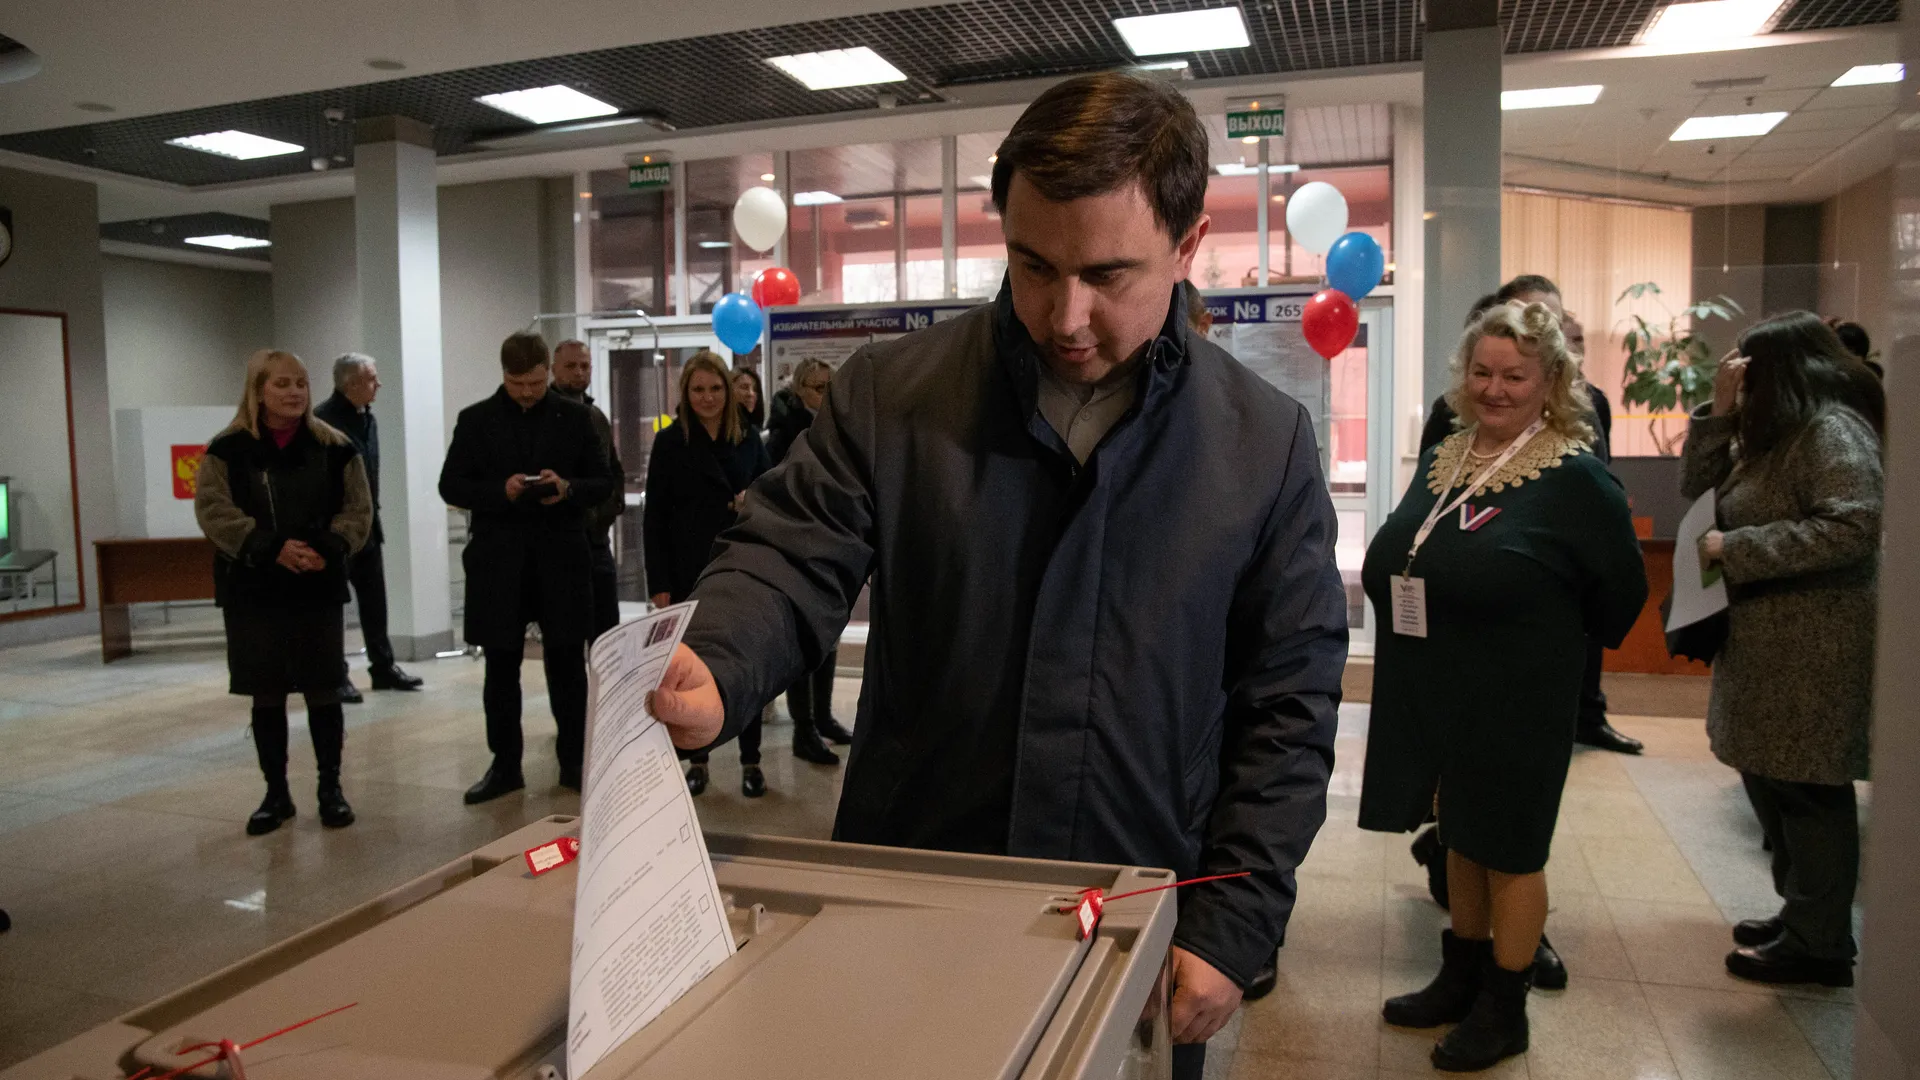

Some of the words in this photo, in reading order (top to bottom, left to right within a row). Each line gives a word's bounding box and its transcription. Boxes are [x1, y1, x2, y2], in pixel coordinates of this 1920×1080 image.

[1228, 114, 1284, 133] ВЫХОД
[630, 166, 670, 184] ВЫХОД
[1233, 301, 1261, 321] №
[1275, 304, 1304, 317] 265
[773, 320, 854, 332] ИЗБИРАТЕЛЬНЫЙ
[855, 317, 901, 329] УЧАСТОК
